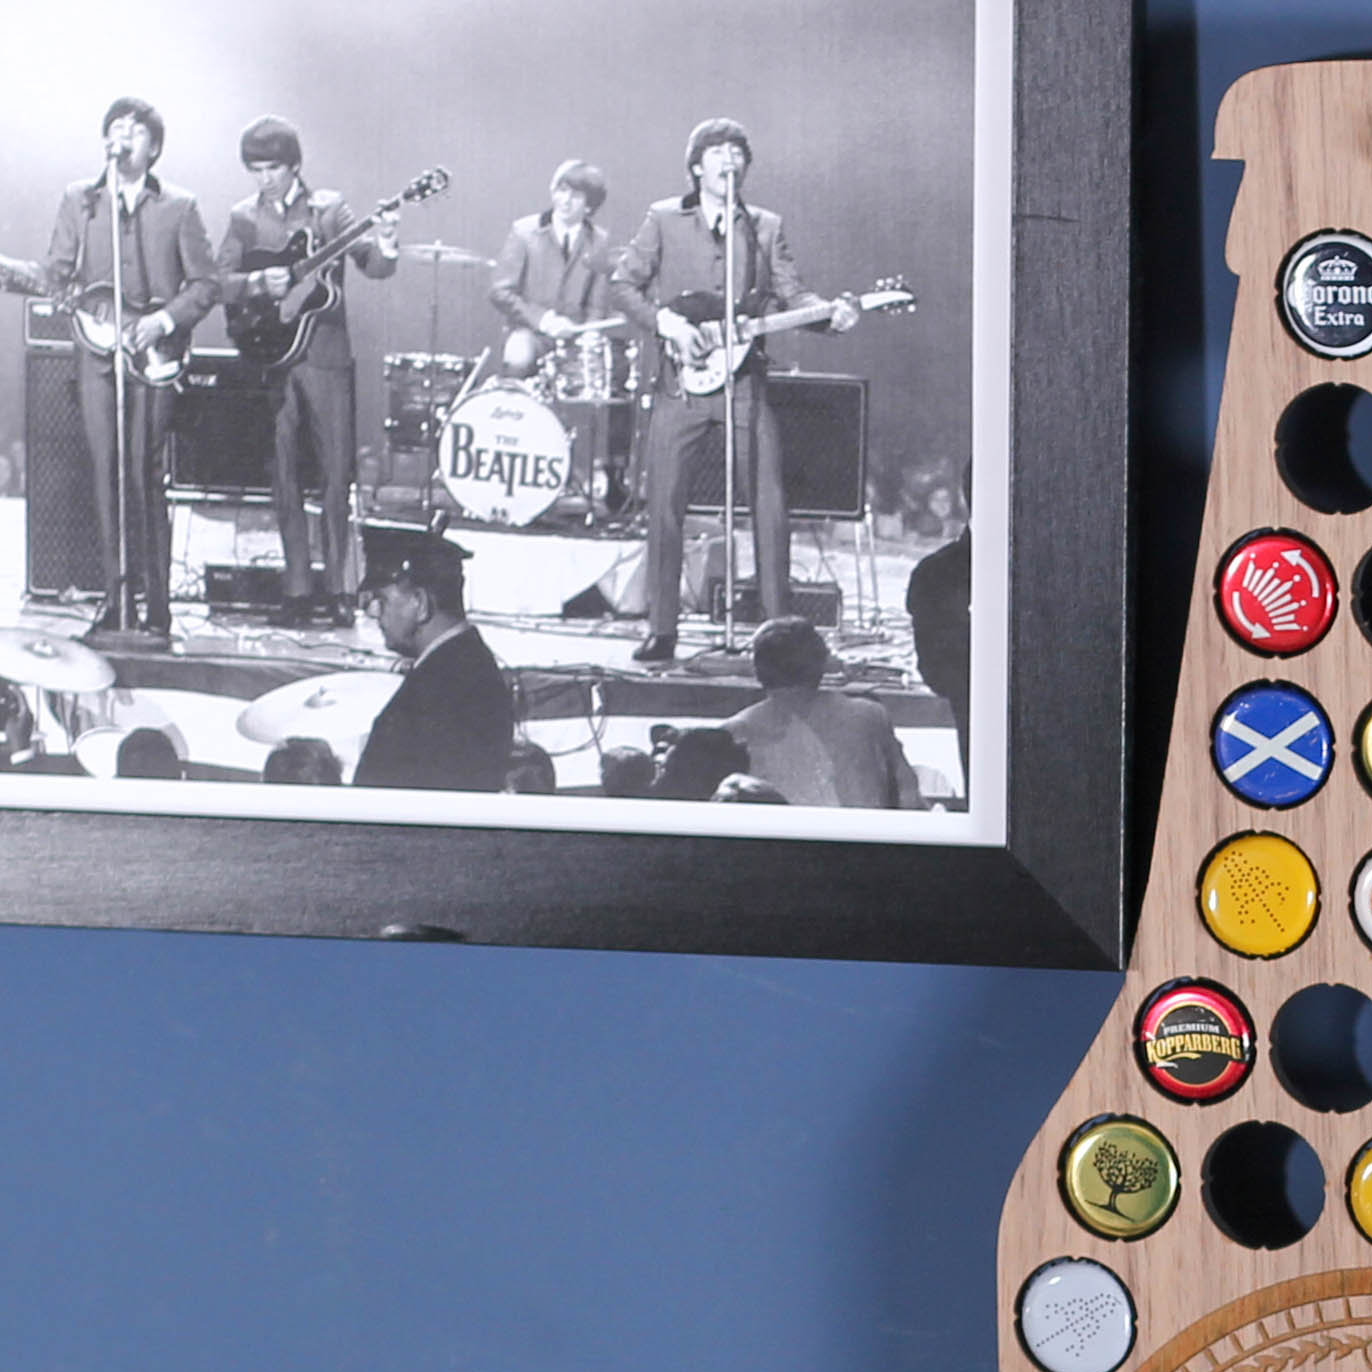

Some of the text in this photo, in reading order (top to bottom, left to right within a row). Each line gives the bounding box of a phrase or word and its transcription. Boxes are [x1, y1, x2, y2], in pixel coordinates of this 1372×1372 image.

[1314, 305, 1365, 326] Extra
[450, 422, 563, 498] BEATLES
[1163, 1023, 1220, 1035] PREMIUM
[1146, 1033, 1242, 1064] KOPPARBERG
